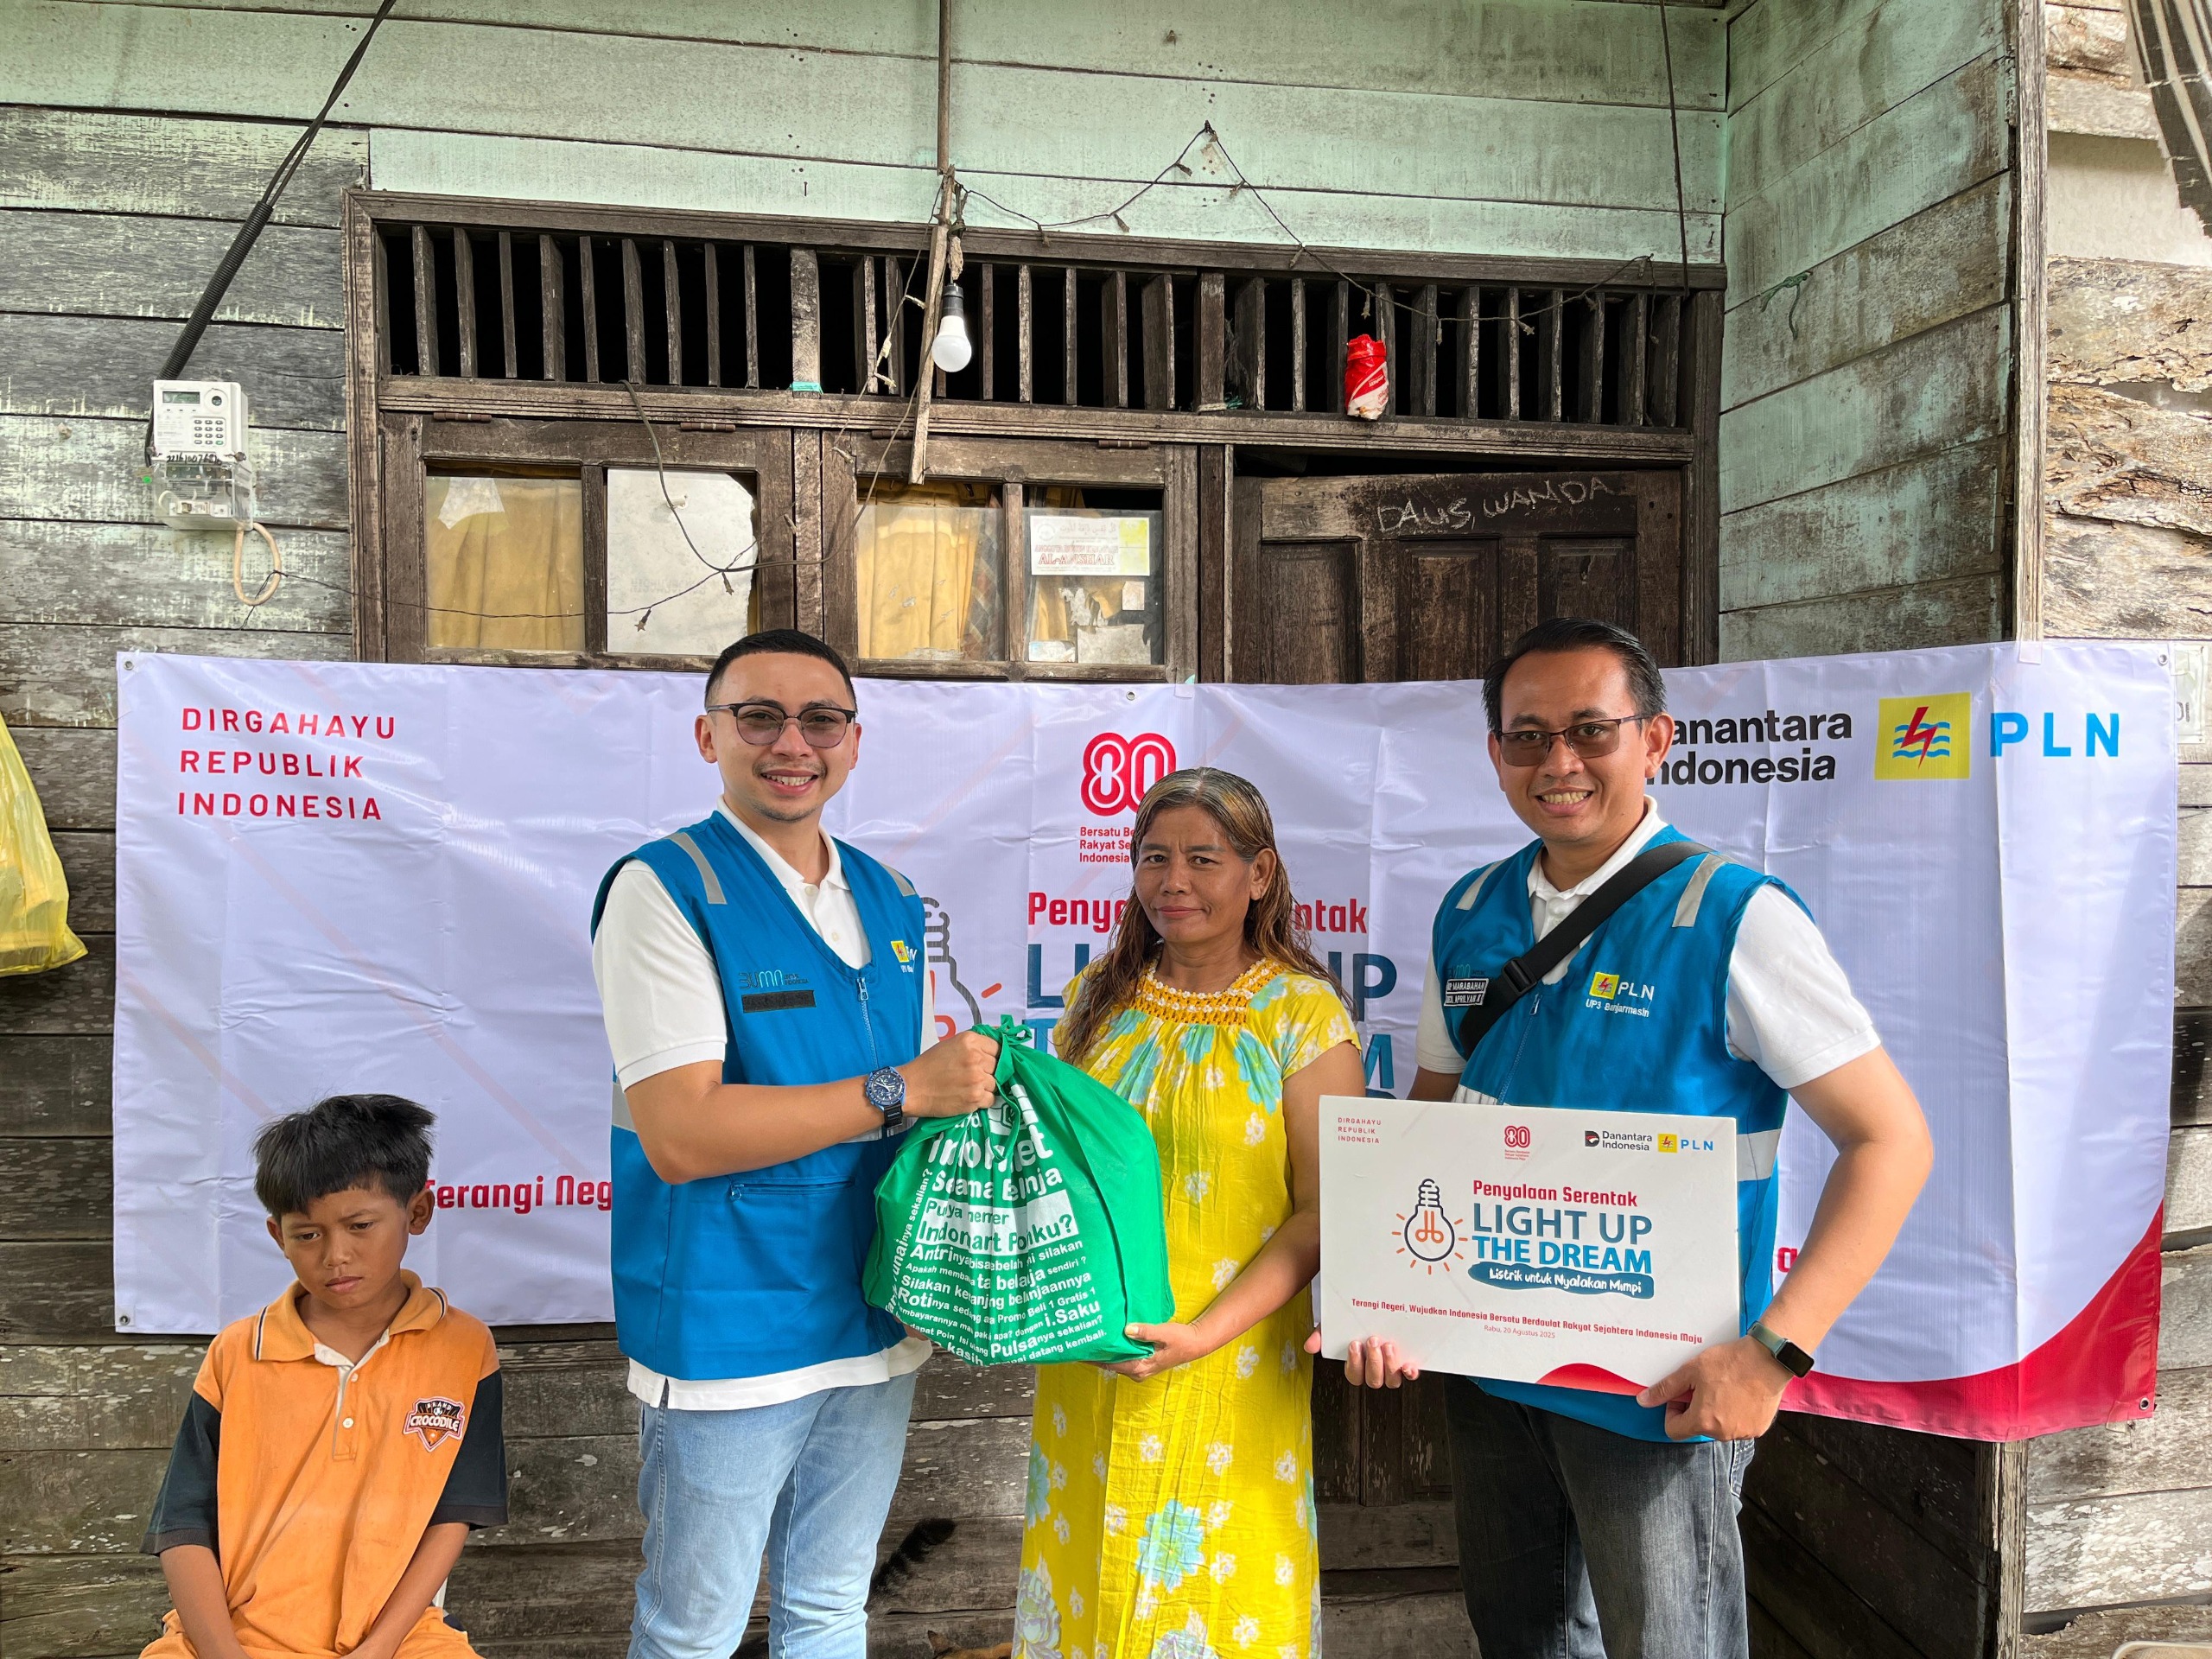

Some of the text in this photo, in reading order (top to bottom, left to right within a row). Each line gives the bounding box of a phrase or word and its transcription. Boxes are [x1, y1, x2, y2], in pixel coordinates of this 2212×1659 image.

[1483, 477, 1614, 518] WANDA
[181, 708, 396, 740] DIRGAHAYU
[1672, 710, 1853, 745] anantara
[1990, 711, 2120, 758] PLN
[180, 750, 364, 779] REPUBLIK
[1080, 732, 1177, 817] 80
[1647, 747, 1836, 785] ndonesia
[178, 792, 382, 820] INDONESIA
[1080, 827, 1121, 837] Bersatu
[1080, 839, 1116, 852] Rakyat
[1080, 852, 1130, 862] Indonesia
[1618, 982, 1655, 1001] PLN
[1586, 998, 1649, 1018] UP3 Banjarmasin
[1338, 1117, 1382, 1126] DIRGAHAYU
[1504, 1125, 1530, 1147] 80
[1602, 1131, 1653, 1141] Danantara
[1602, 1141, 1649, 1151] Indonesia
[1680, 1139, 1713, 1151] PLN
[1473, 1179, 1637, 1207] Penyalaan Serentak
[1473, 1203, 1652, 1245] LIGHT UP
[893, 1224, 912, 1281] unainya
[1039, 1240, 1083, 1261] silakan
[1472, 1235, 1652, 1274] THE DREAM
[906, 1262, 938, 1274] Apakah
[1047, 1258, 1079, 1274] sendiri
[901, 1274, 950, 1294] Silakan
[1489, 1268, 1642, 1295] Listrik untuk Nyalakan Mimpi
[898, 1287, 950, 1310] Rotinya
[997, 1313, 1026, 1323] Promo
[1027, 1302, 1046, 1318] Beli
[1048, 1300, 1054, 1309] 1
[1057, 1291, 1089, 1306] Gratis
[1090, 1287, 1096, 1295] 1
[898, 1304, 957, 1327] embayarannya
[993, 1330, 1013, 1341] apa?
[1045, 1300, 1101, 1327] i.Saku
[1351, 1299, 1702, 1344] Terangi Negeri, Wujudkan Indonesia Bersatu Berdaulat Rakyat Sejahtera Indonesia Maju
[1484, 1325, 1502, 1333] Rabu,
[1513, 1328, 1538, 1337] Agustus
[936, 1329, 955, 1340] Poin
[990, 1331, 1055, 1358] Pulsanya
[1057, 1314, 1103, 1338] sekalian?
[1028, 1343, 1064, 1360] datang
[427, 1401, 452, 1410] BRAND
[410, 1415, 460, 1432] CROCODILE
